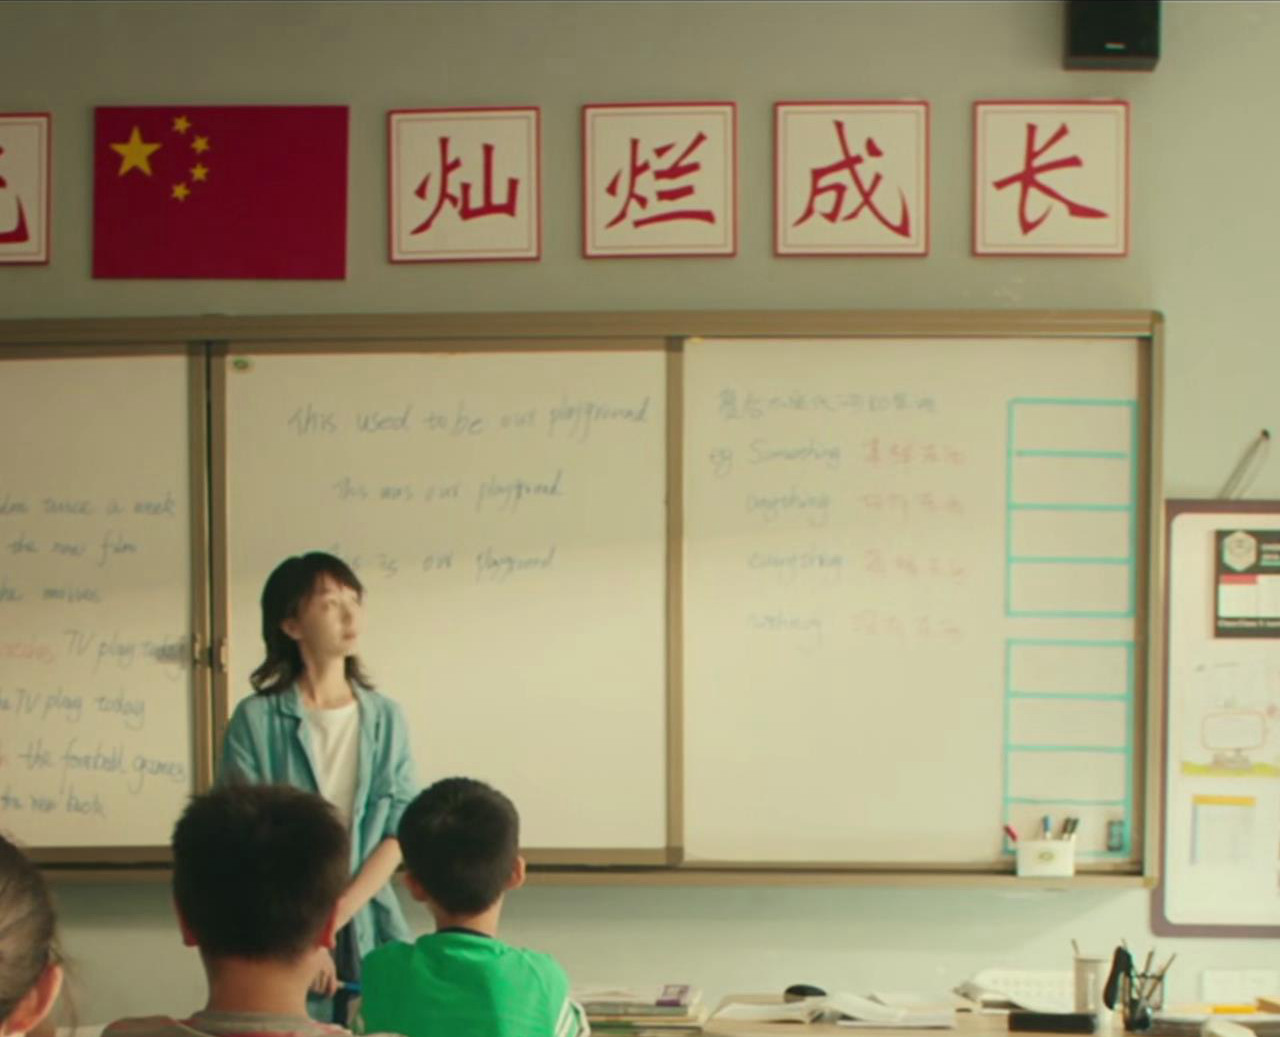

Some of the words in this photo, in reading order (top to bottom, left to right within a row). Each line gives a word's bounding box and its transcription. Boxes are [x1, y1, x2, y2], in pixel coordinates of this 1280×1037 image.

[287, 402, 338, 438] This
[355, 403, 414, 435] used
[421, 406, 447, 432] to
[450, 397, 485, 437] be
[500, 408, 537, 431] our
[546, 395, 650, 446] playground
[105, 498, 125, 516] a
[424, 481, 462, 503] our
[475, 467, 565, 515] playground
[7, 531, 39, 556] the
[96, 529, 137, 568] film
[421, 549, 456, 573] our
[474, 545, 558, 586] playground
[63, 629, 96, 656] TV
[91, 629, 136, 675] play
[15, 687, 41, 715] TV
[41, 685, 83, 724] play
[18, 737, 54, 770] the
